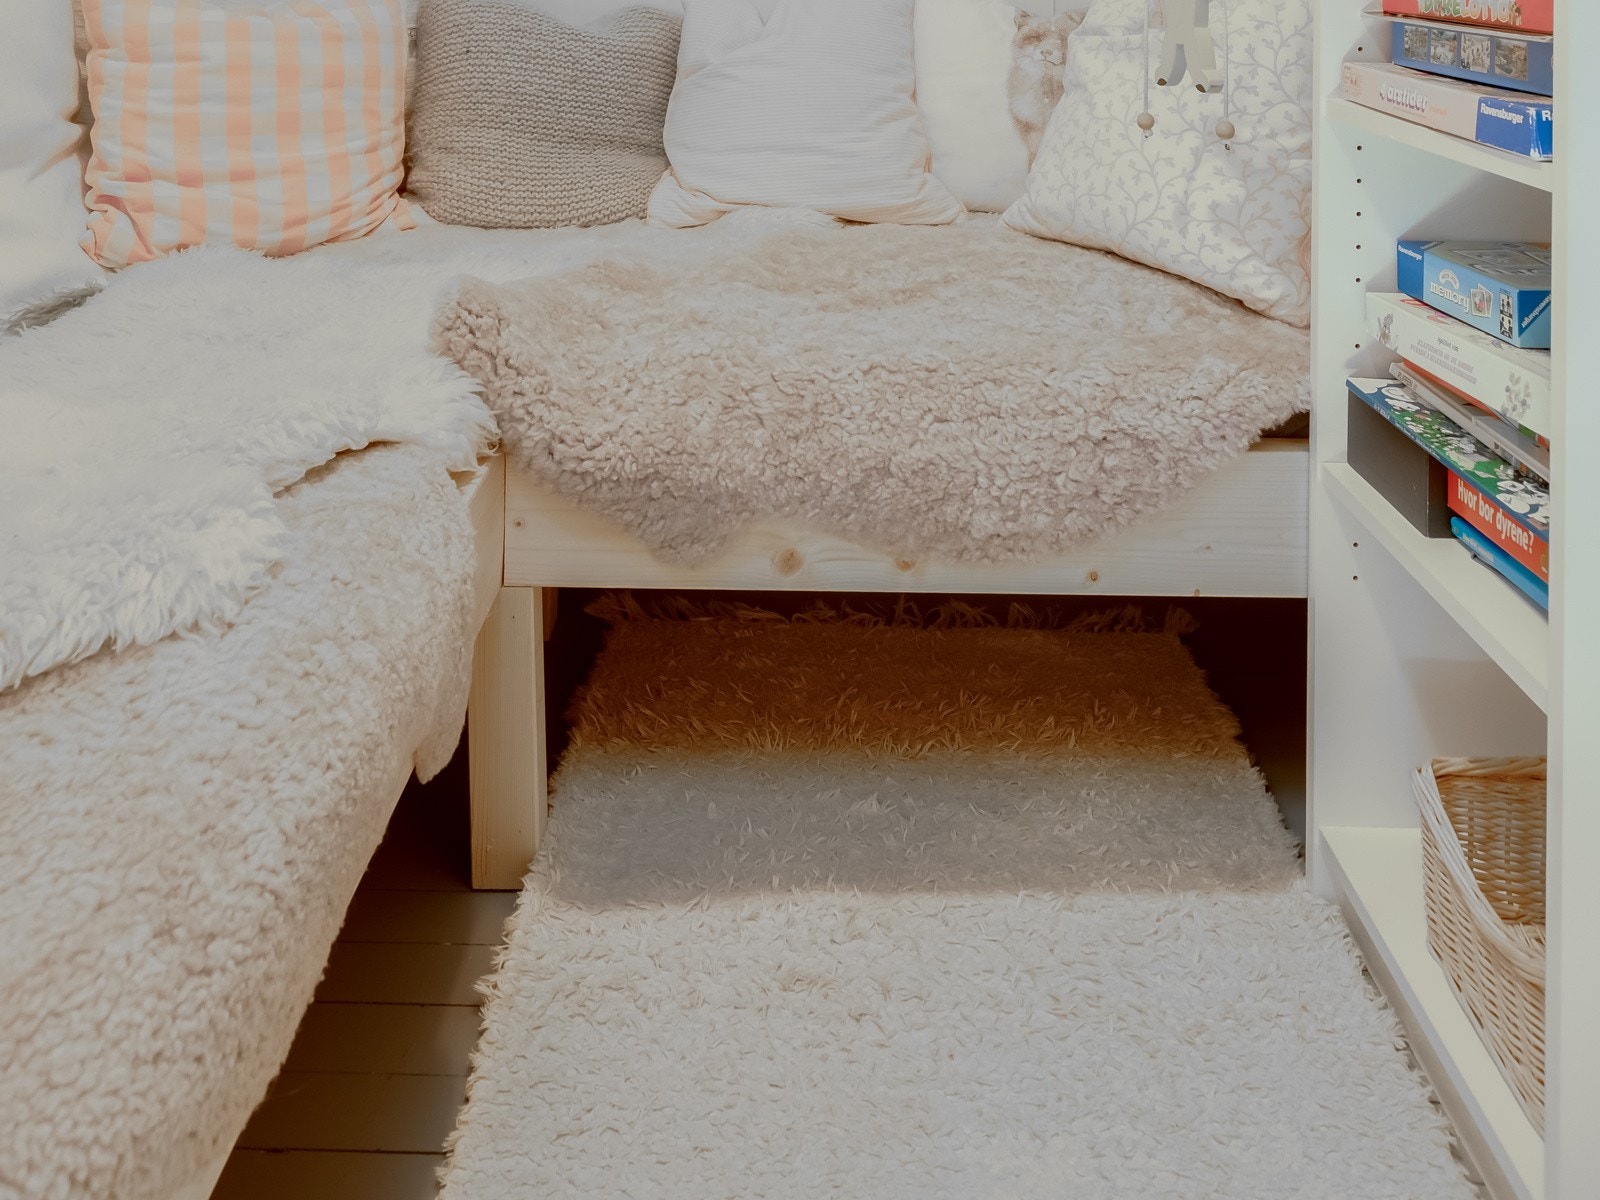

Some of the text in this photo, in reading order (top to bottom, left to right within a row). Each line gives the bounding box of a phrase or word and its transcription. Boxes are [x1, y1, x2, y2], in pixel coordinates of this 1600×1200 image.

[1481, 103, 1524, 125] Ravensburger
[1430, 281, 1470, 314] memory
[1521, 293, 1552, 328] avensburger
[1458, 478, 1477, 511] Hvor
[1479, 492, 1494, 523] bor
[1496, 507, 1535, 554] dyrene?
